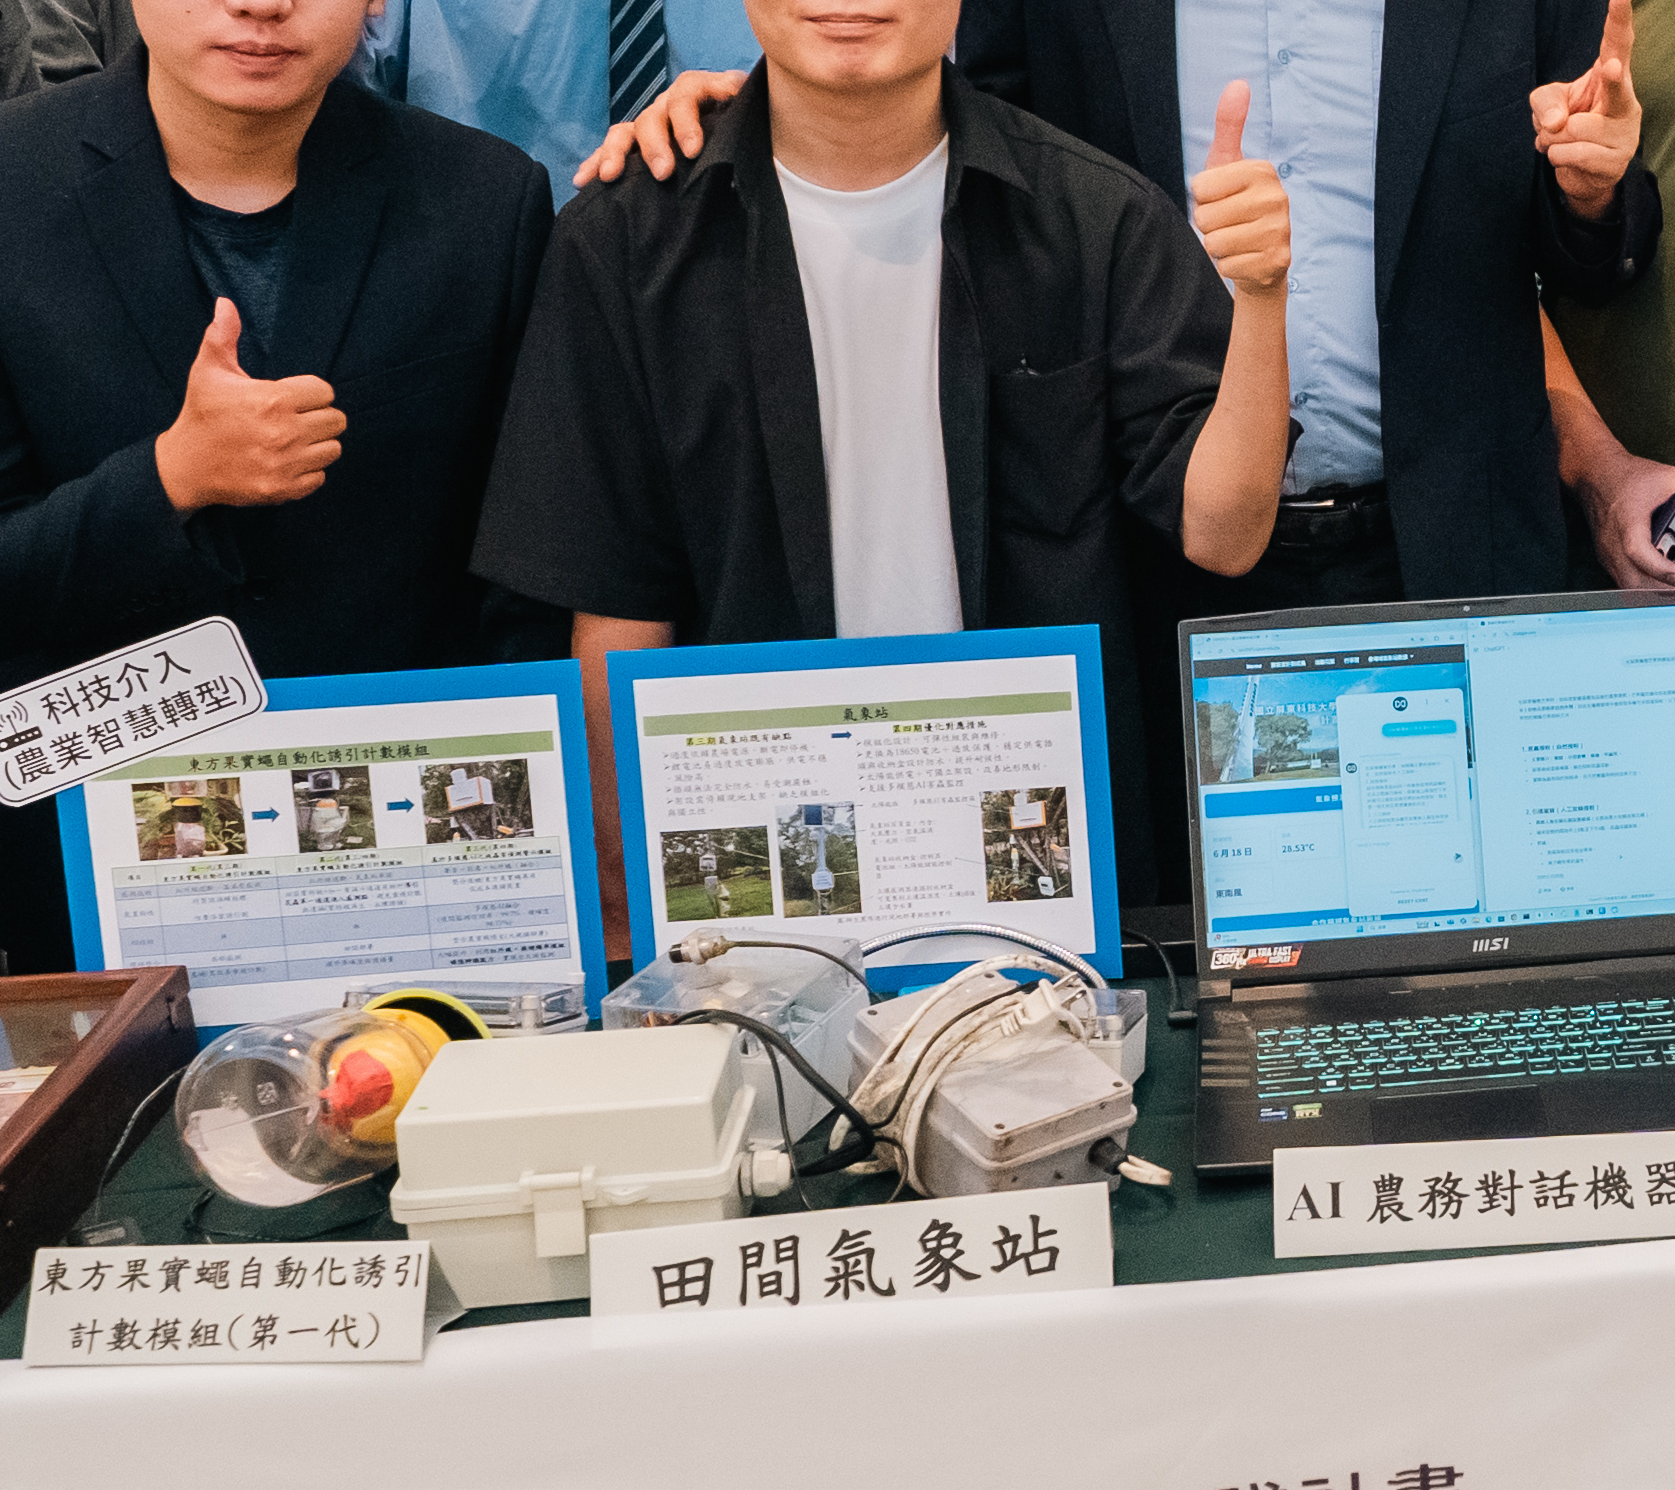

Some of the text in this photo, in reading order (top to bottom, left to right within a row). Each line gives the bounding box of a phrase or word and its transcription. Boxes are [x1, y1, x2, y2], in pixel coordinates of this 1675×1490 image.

[38, 647, 180, 723] 科技介入
[2, 672, 248, 795] (農業智慧轉型)
[843, 706, 889, 722] 氣象站
[187, 743, 430, 773] 東方果實蠅自動化誘引計數模組
[1286, 1180, 1344, 1223] AI
[35, 1250, 426, 1295] 東方果實蠅自動化誘引
[653, 1211, 1063, 1311] 田間氣象站
[68, 1311, 383, 1356] 計數模組(第一代)
